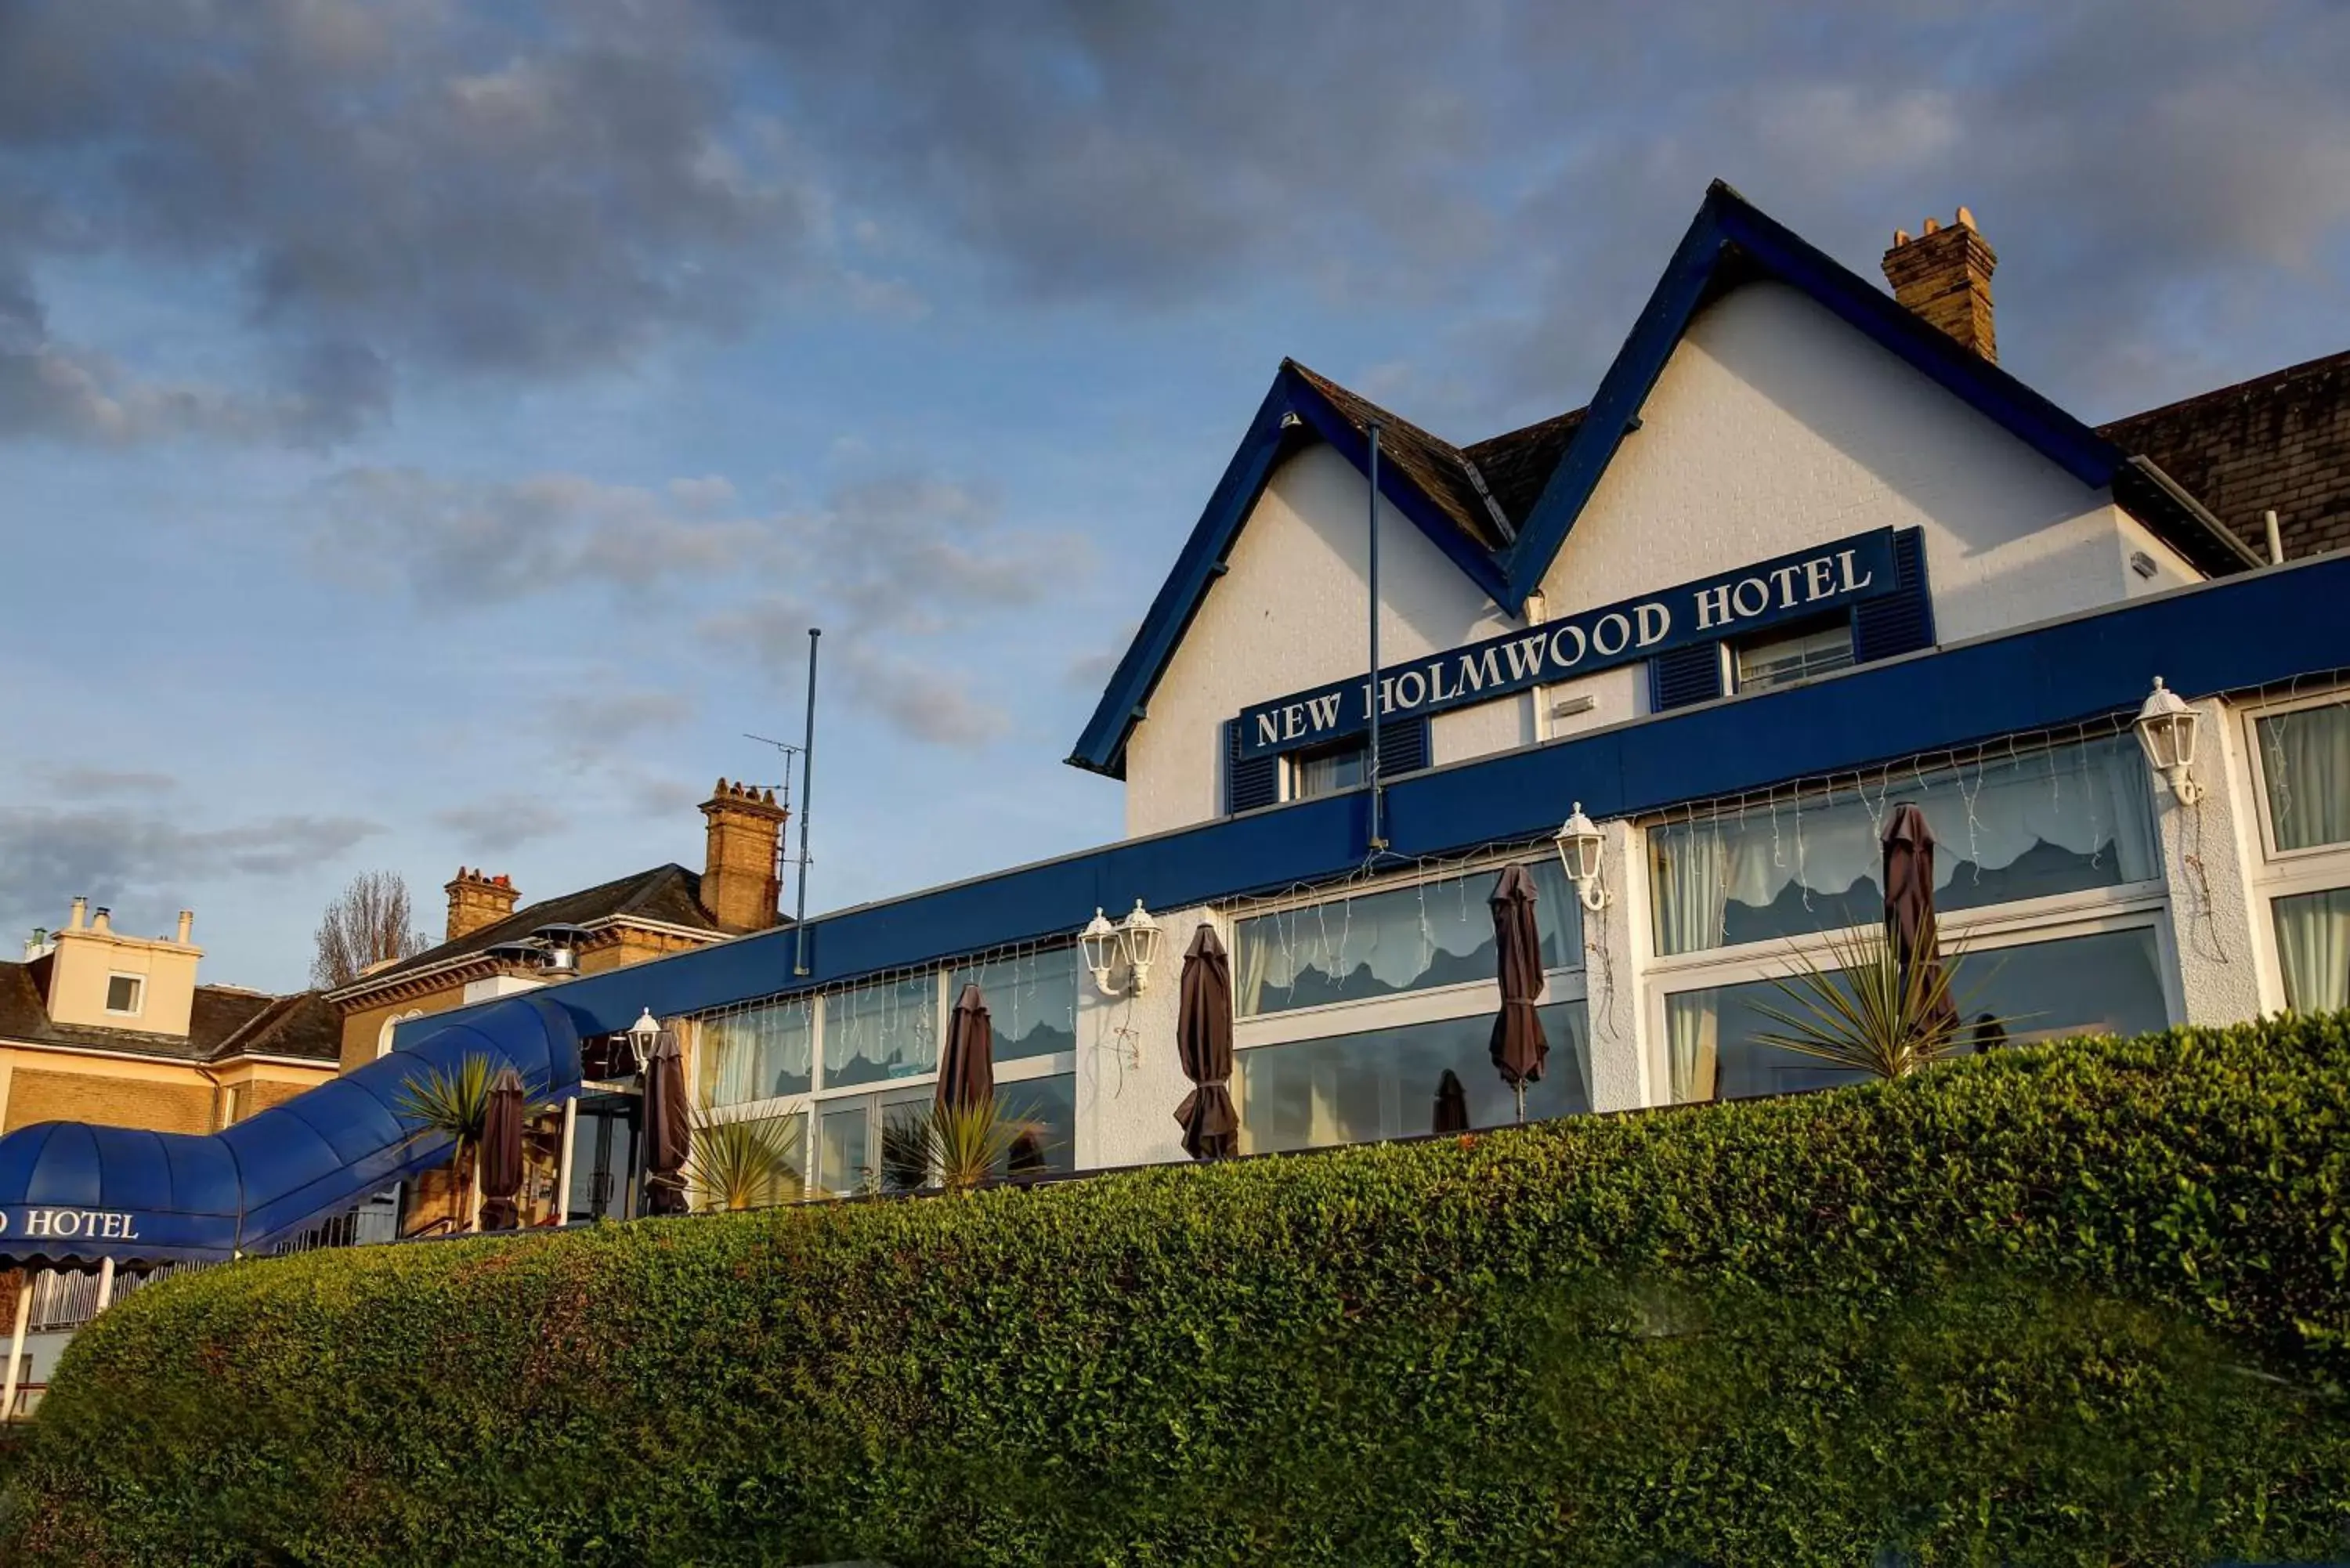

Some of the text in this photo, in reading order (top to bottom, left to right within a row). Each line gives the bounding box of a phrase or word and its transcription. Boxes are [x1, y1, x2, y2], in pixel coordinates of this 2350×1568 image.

[1256, 550, 1872, 747] NEW HOLMWOOD HOTEL
[25, 1210, 139, 1240] HOTEL
